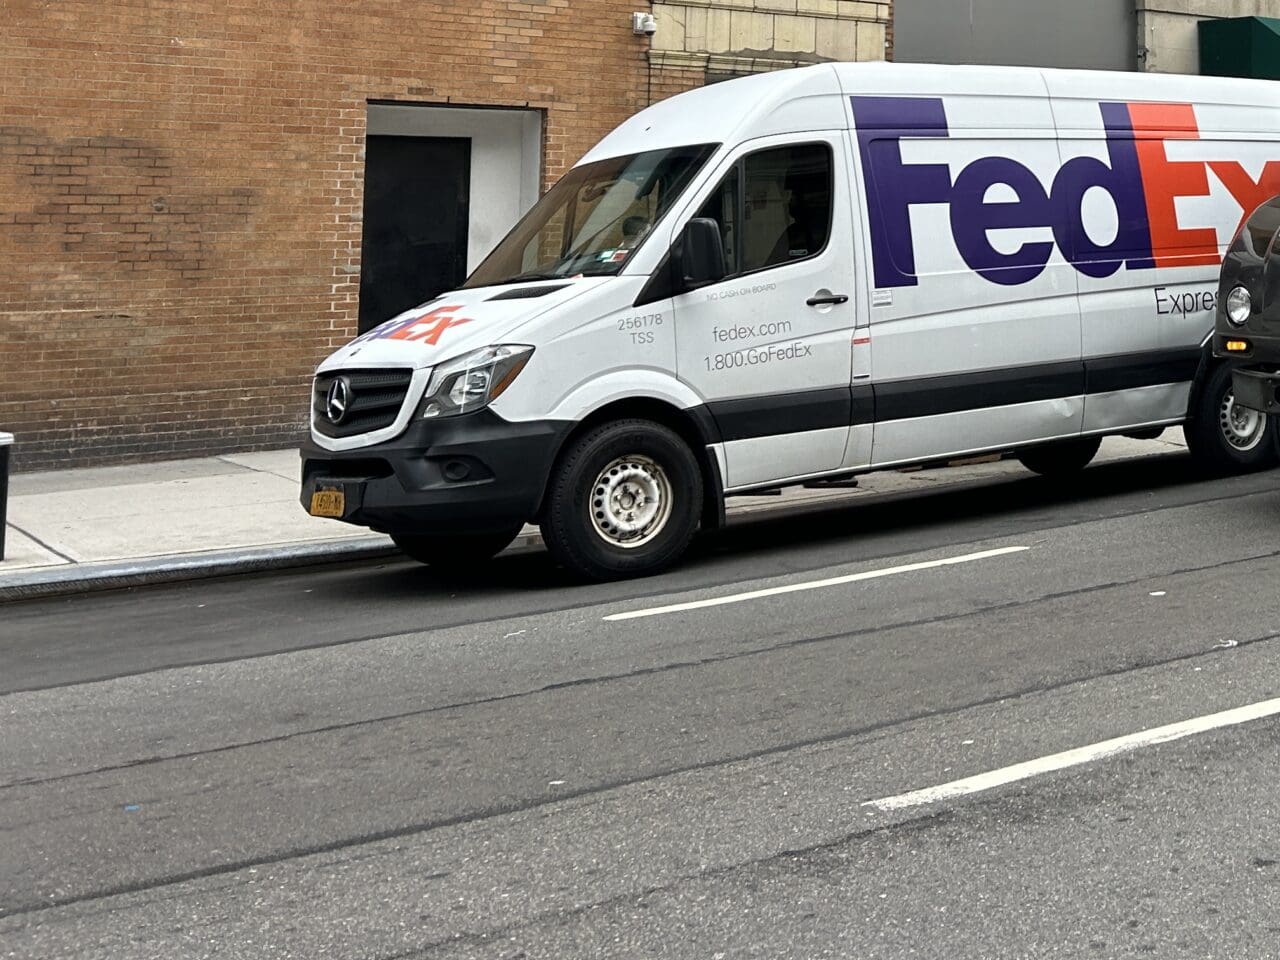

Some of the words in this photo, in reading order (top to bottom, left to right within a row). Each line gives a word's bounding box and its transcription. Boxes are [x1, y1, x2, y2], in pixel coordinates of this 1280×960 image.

[1154, 287, 1219, 320] Expre
[617, 313, 663, 331] 256178
[712, 319, 792, 343] fedex.com
[630, 331, 655, 344] TSS
[703, 342, 813, 372] 1.800.GoFedEx
